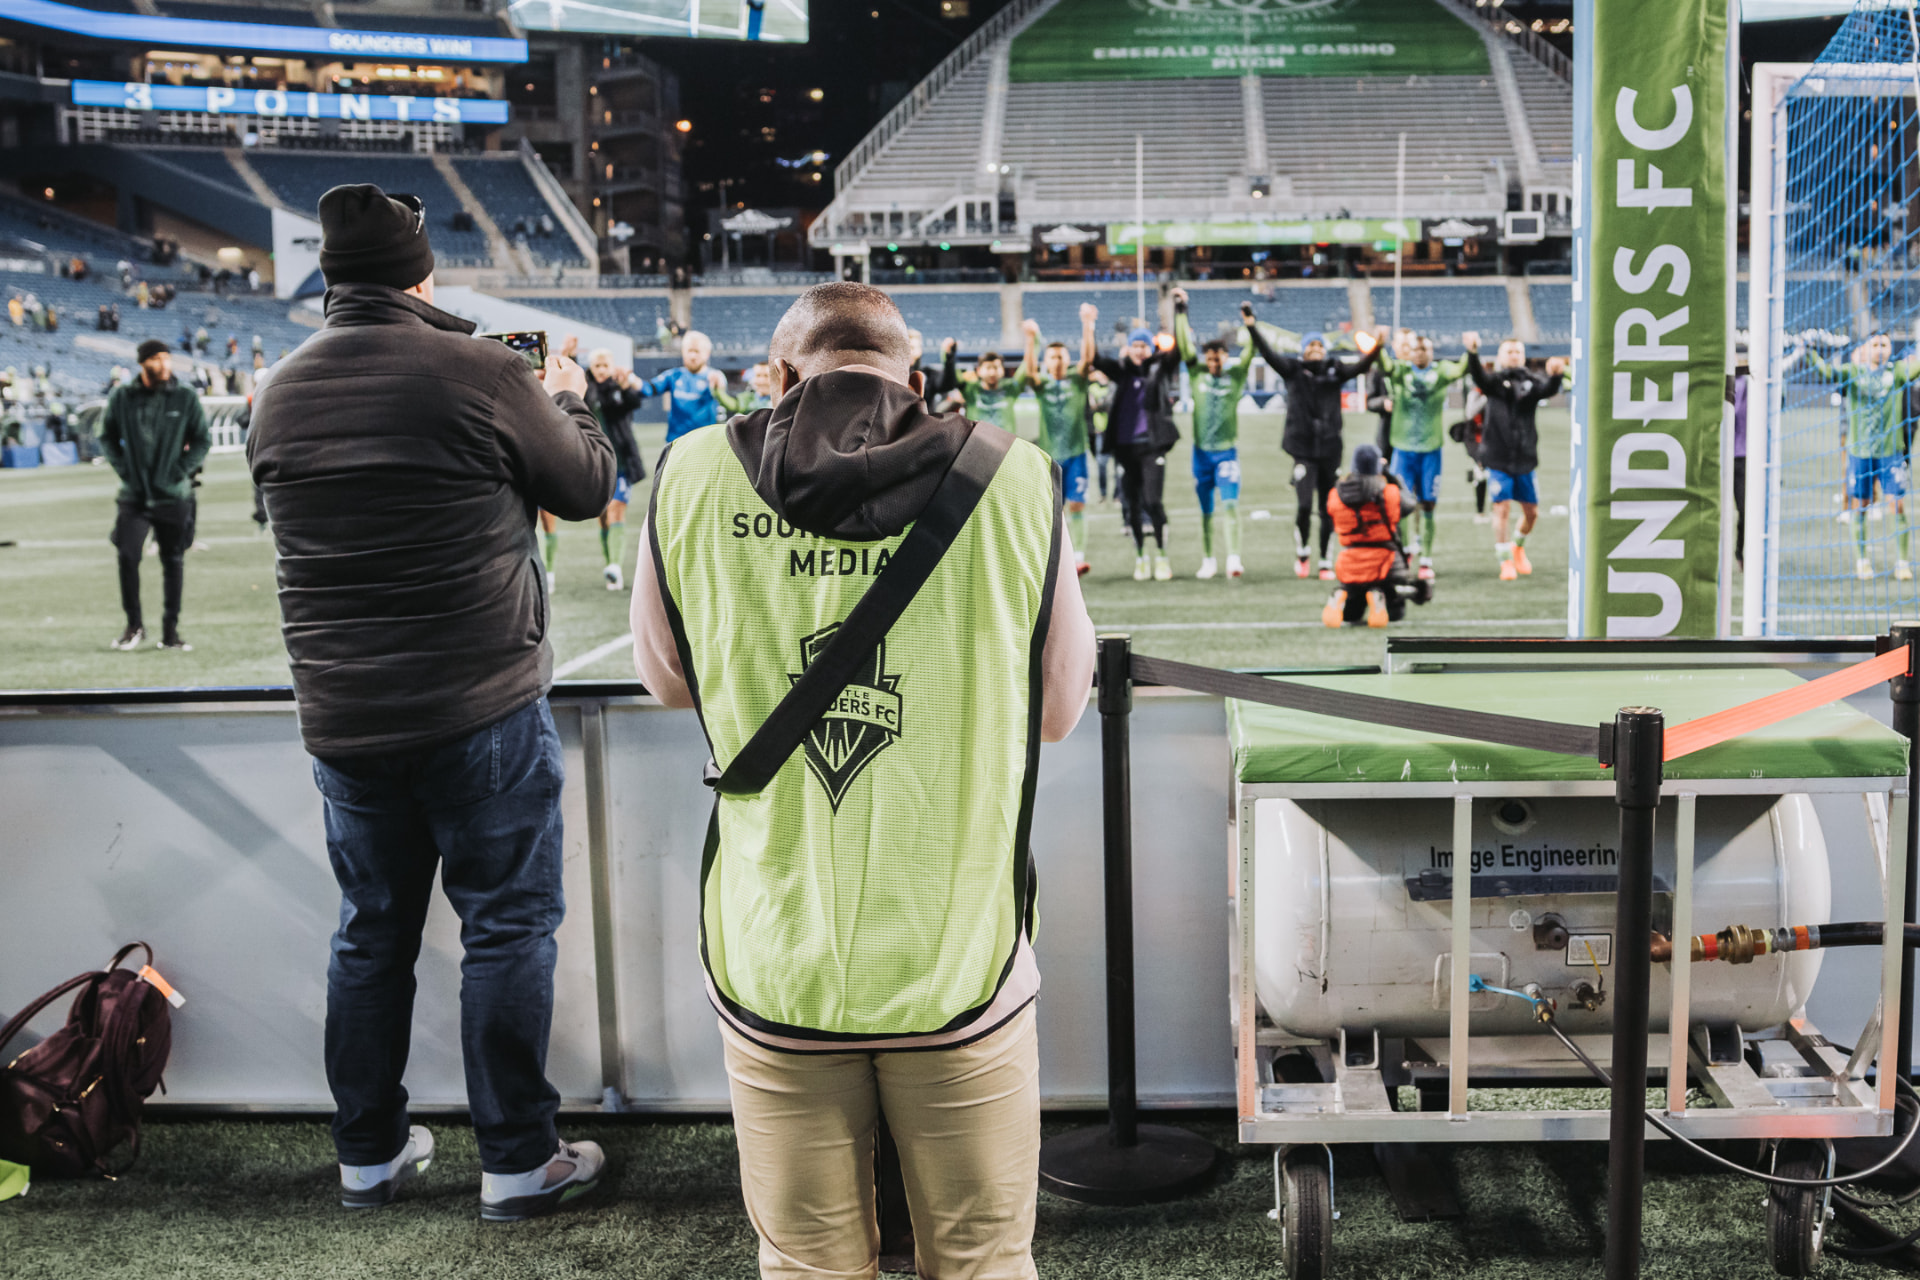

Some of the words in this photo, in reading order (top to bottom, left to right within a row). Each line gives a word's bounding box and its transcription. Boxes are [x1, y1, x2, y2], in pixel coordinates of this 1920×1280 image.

[329, 33, 428, 54] SOUNDERS
[1094, 47, 1209, 59] EMERALD
[1214, 44, 1296, 57] QUEEN
[1302, 43, 1396, 55] CASINO
[1212, 57, 1286, 69] PITCH
[124, 83, 153, 110] 3
[206, 87, 461, 123] POINTS
[1615, 83, 1694, 215] FC
[790, 548, 892, 577] MEDIA
[875, 704, 896, 725] FC
[1430, 846, 1495, 873] Imge
[1501, 843, 1620, 872] Engineerin
